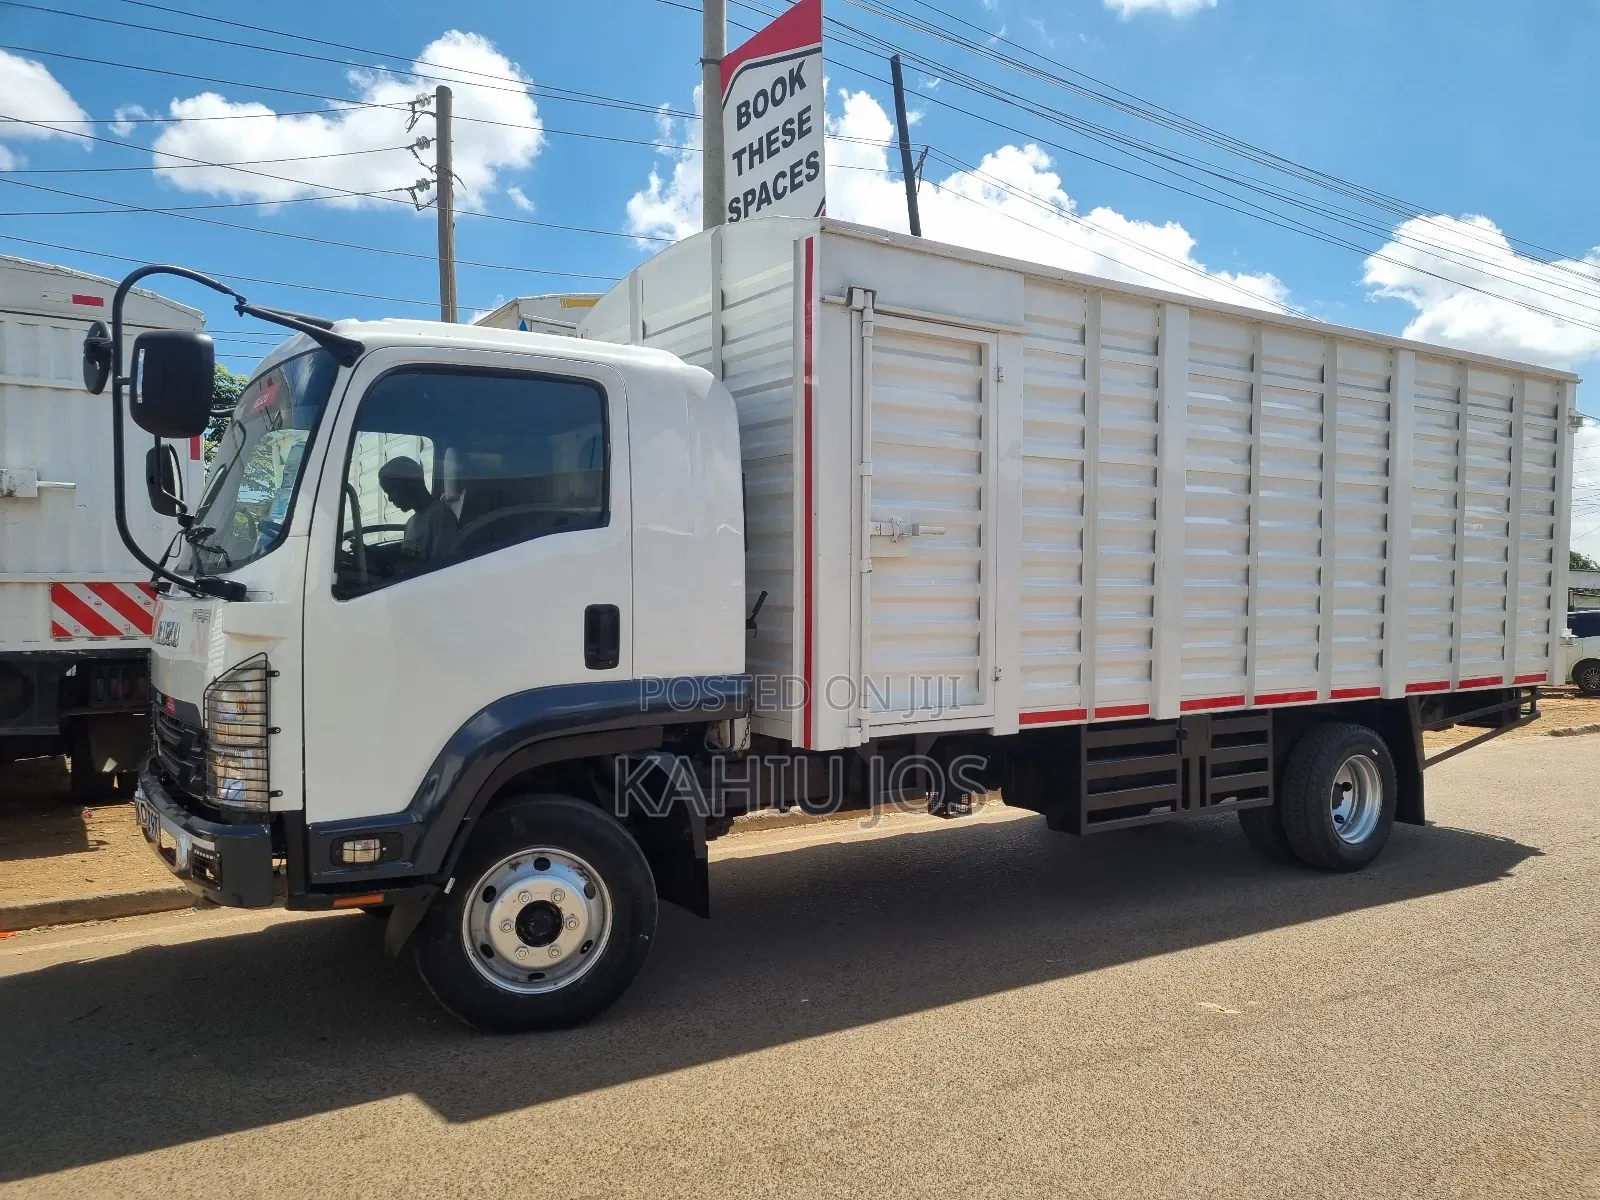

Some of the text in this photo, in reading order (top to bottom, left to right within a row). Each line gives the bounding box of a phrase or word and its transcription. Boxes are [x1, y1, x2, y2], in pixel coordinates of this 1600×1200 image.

[736, 59, 807, 132] BOOK
[732, 104, 812, 178] THESE
[727, 150, 820, 223] SPACES
